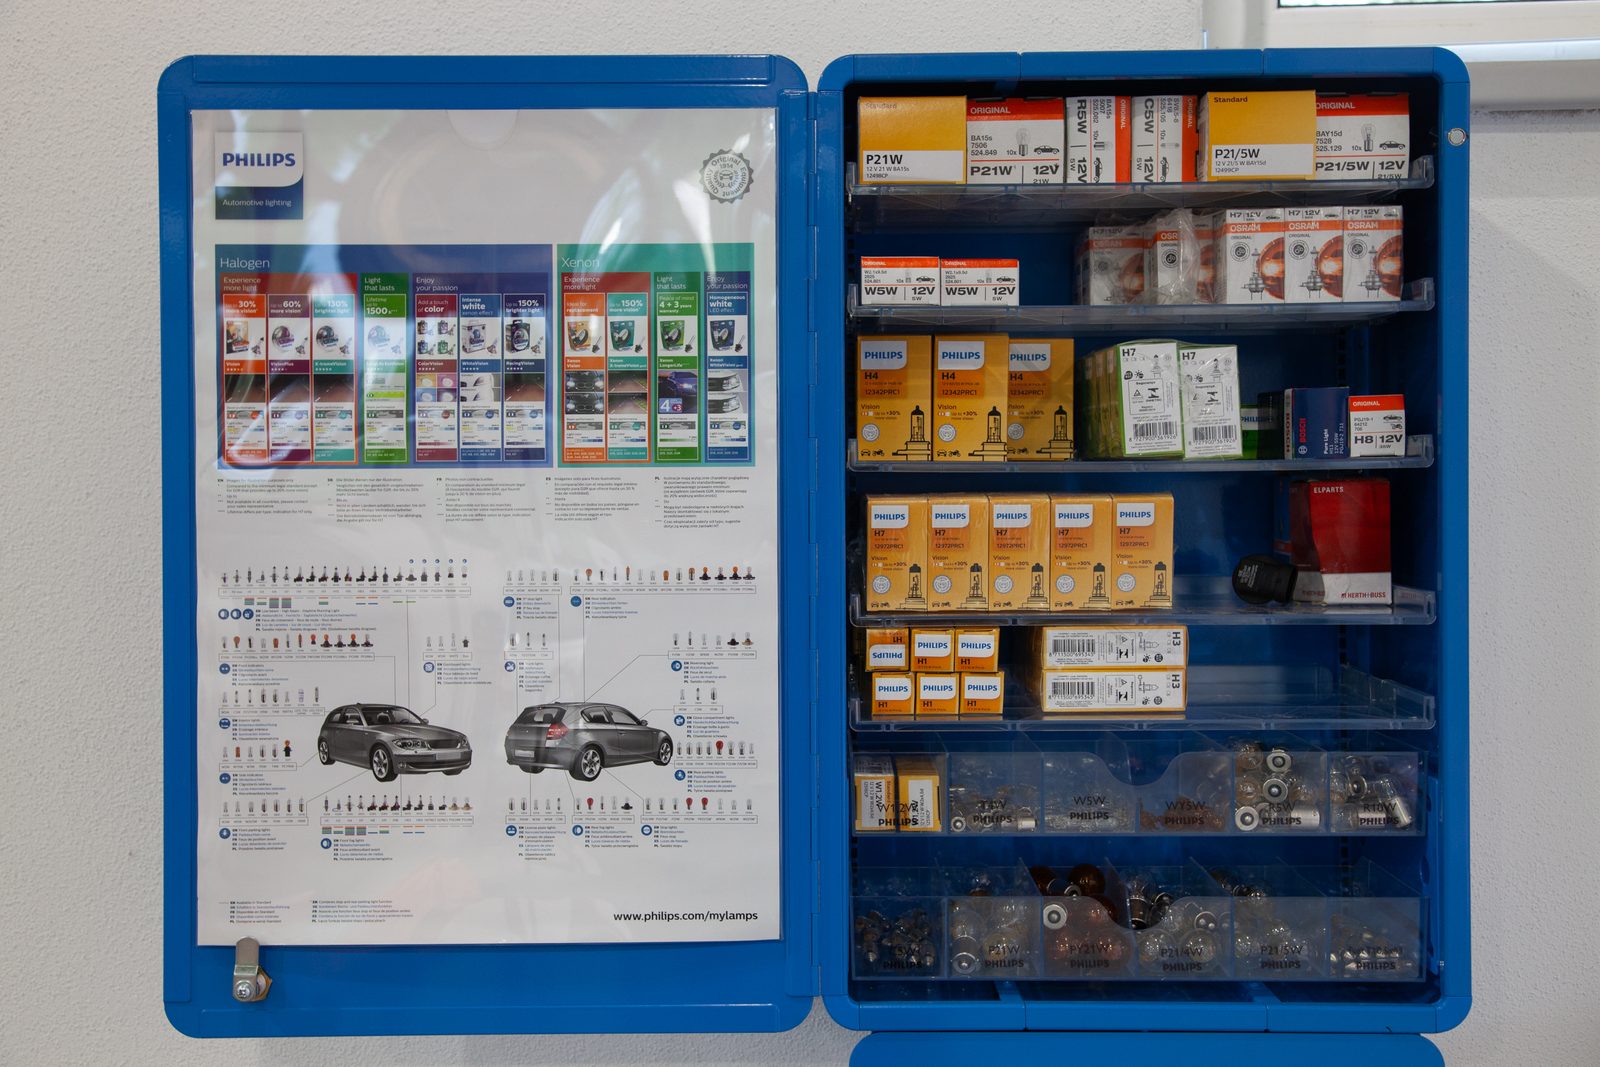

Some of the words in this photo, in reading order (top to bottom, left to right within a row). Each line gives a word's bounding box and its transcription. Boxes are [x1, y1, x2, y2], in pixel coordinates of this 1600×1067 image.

[1077, 99, 1087, 134] R5W
[1144, 99, 1154, 133] C5W
[866, 154, 903, 164] P21W
[1215, 149, 1260, 160] P21/5W
[223, 153, 295, 166] PHILIPS
[712, 156, 741, 166] Original
[1137, 158, 1142, 170] 5W
[970, 166, 1013, 176] P21W
[1032, 165, 1059, 175] 12V
[1078, 157, 1087, 183] 12V
[1144, 156, 1153, 182] 12V
[1315, 161, 1369, 171] P21/5W
[1379, 161, 1405, 170] 12V
[220, 258, 270, 270] Halogen
[561, 257, 600, 268] Xenon
[865, 287, 897, 295] W5W
[912, 287, 935, 295] 12V
[945, 287, 978, 295] W5W
[992, 287, 1016, 295] 12V
[864, 351, 903, 360] PHILIPS
[942, 351, 980, 360] PHILIPS
[1010, 353, 1046, 361] PHILIPS
[942, 372, 955, 380] H4
[1354, 436, 1373, 444] H8
[1379, 434, 1402, 443] 12V
[1172, 631, 1181, 646] H3
[1172, 674, 1180, 689] H3
[1074, 796, 1106, 805] W5W
[1165, 801, 1205, 810] WY5W
[1269, 803, 1295, 812] R5W
[1364, 803, 1397, 812] R10W
[1070, 812, 1109, 820] PHILIPS
[1165, 816, 1204, 825] PHILIPS
[1360, 818, 1399, 826] PHILIPS
[613, 911, 758, 922] www.philips.com/mylamps
[989, 946, 1020, 955] P21W
[1070, 946, 1109, 955] PY21W
[1161, 948, 1203, 957] P21/4W
[1261, 946, 1303, 955] P21/5W
[1163, 964, 1202, 972] PHILIPS
[1356, 962, 1396, 970] PHILIPS
